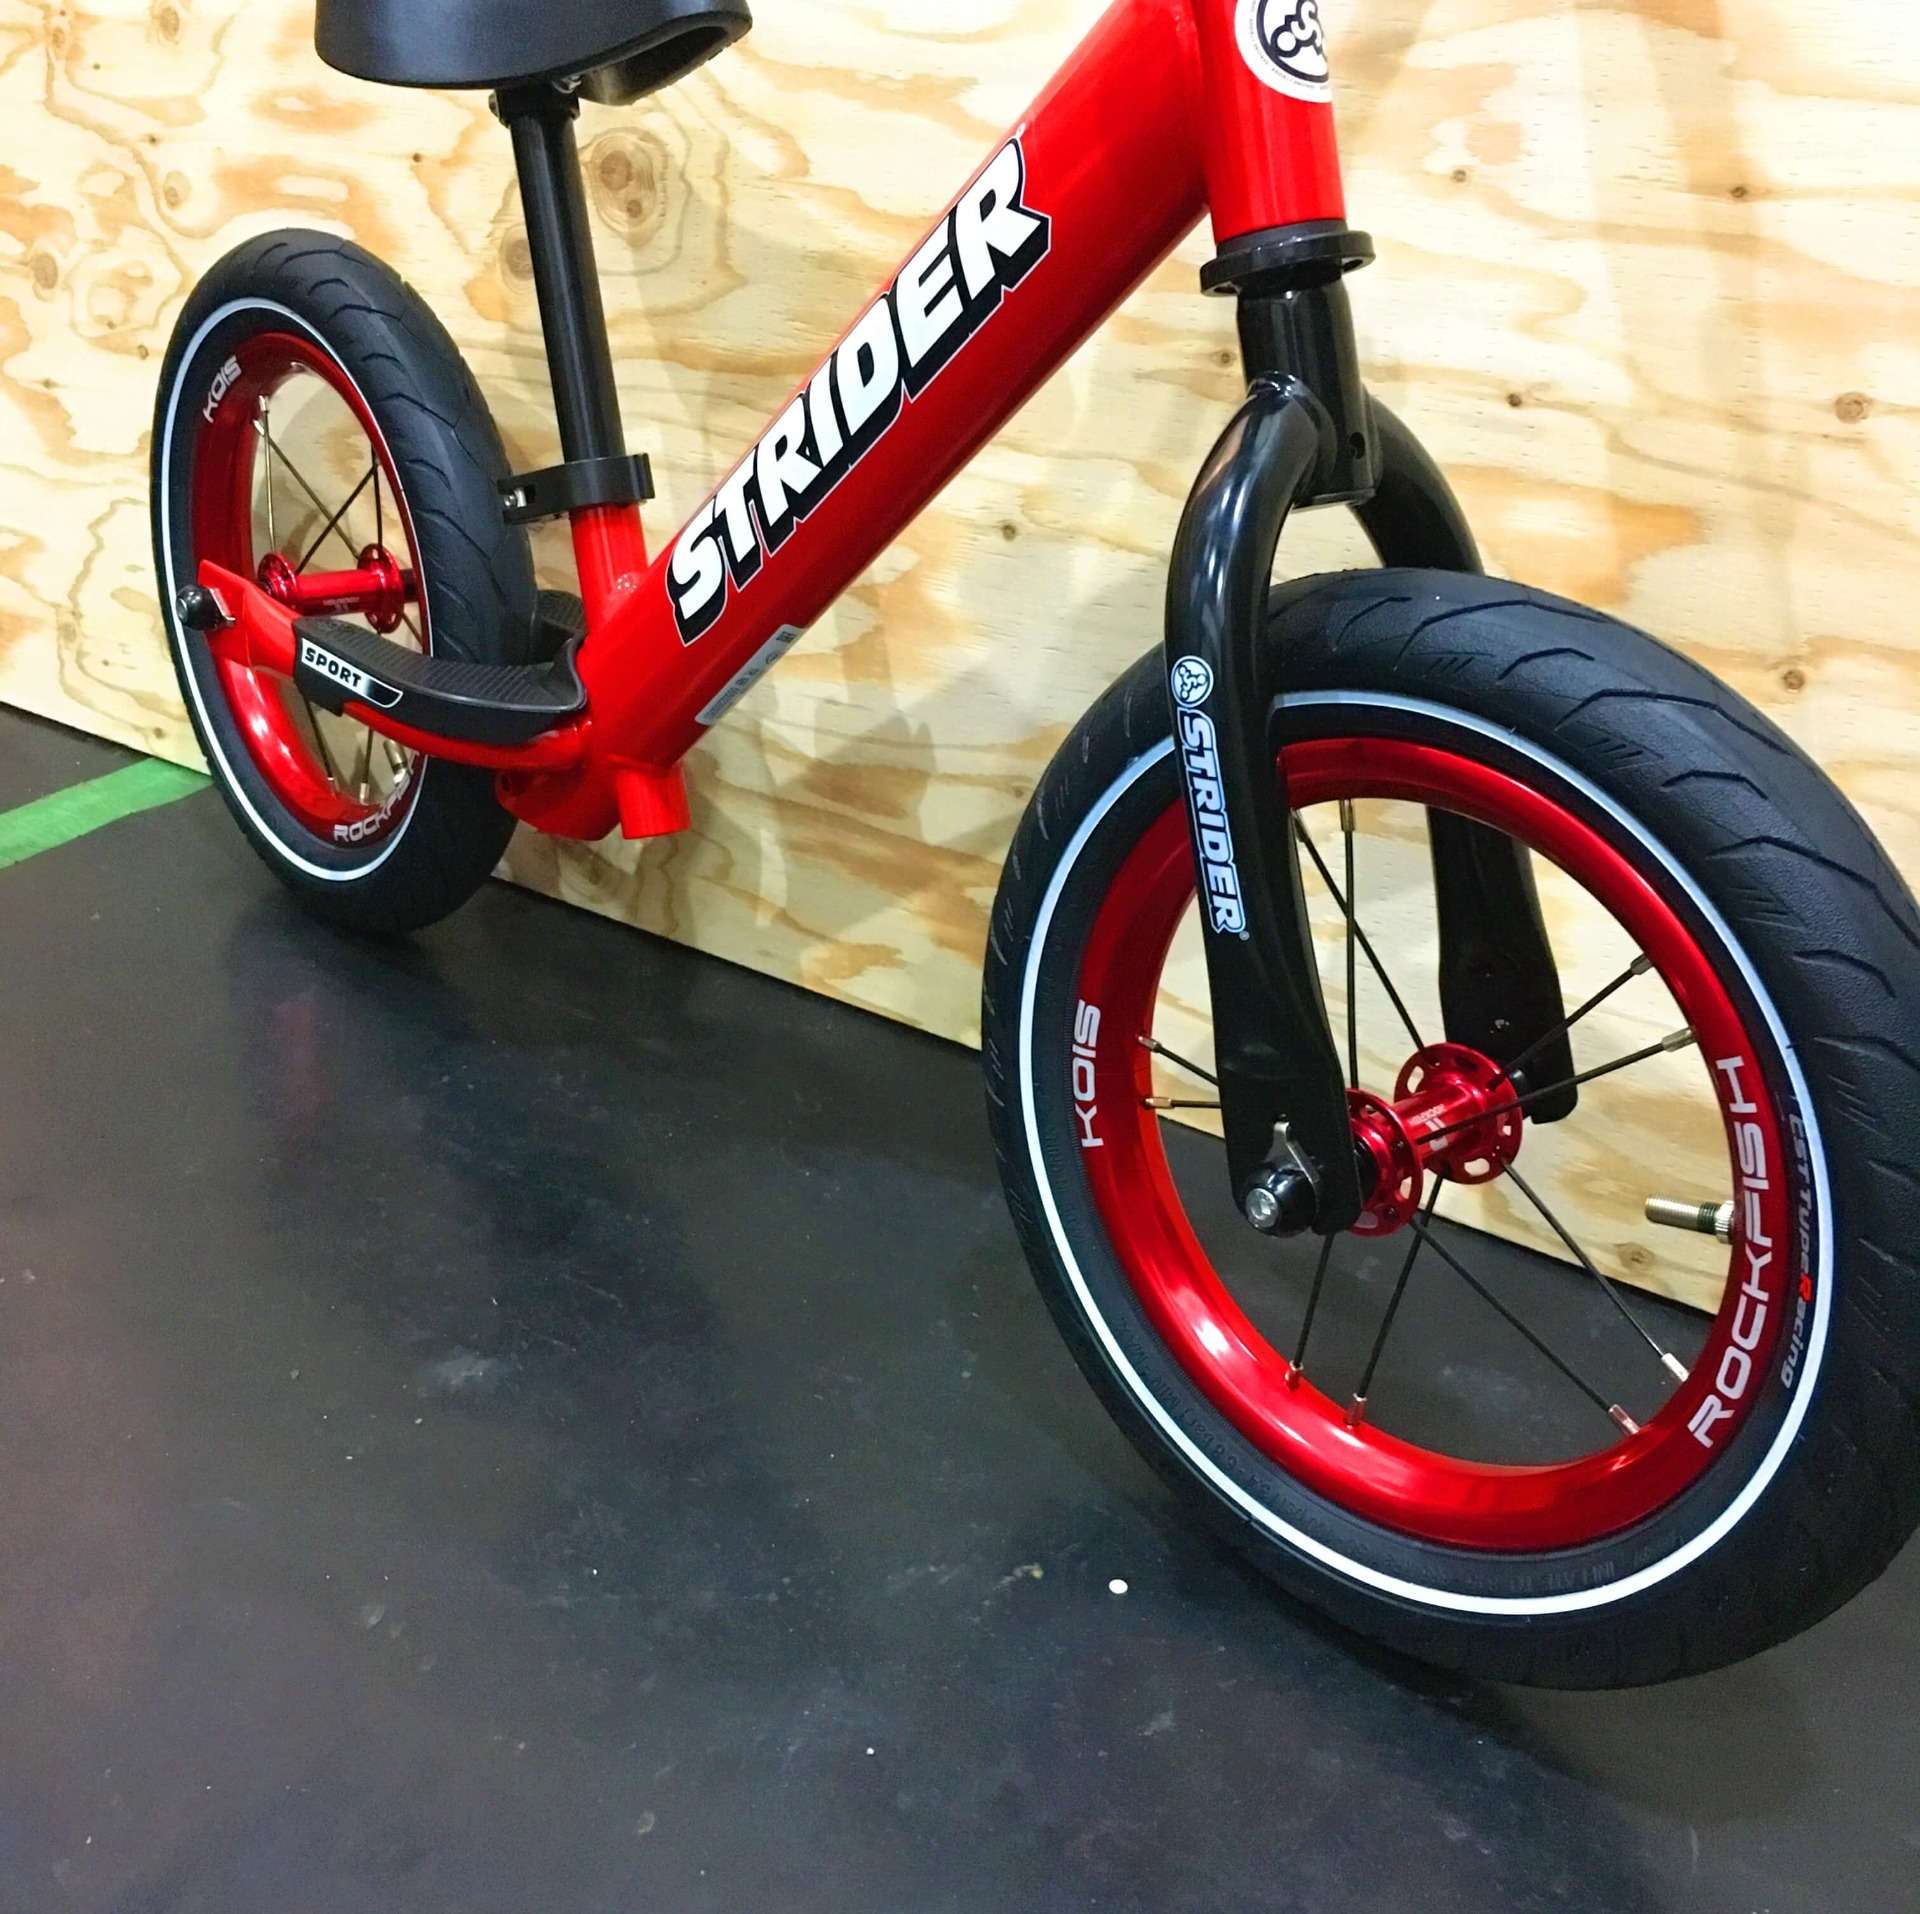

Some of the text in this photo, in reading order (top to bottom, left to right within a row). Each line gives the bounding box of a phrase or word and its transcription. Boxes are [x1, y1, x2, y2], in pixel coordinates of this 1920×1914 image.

[202, 354, 242, 424] KOIS
[668, 138, 1051, 645] STRIDER
[305, 647, 361, 687] SPORT
[1178, 709, 1246, 932] STRIDER
[1072, 999, 1104, 1147] KOIS
[1687, 1055, 1772, 1449] ROCKFISH
